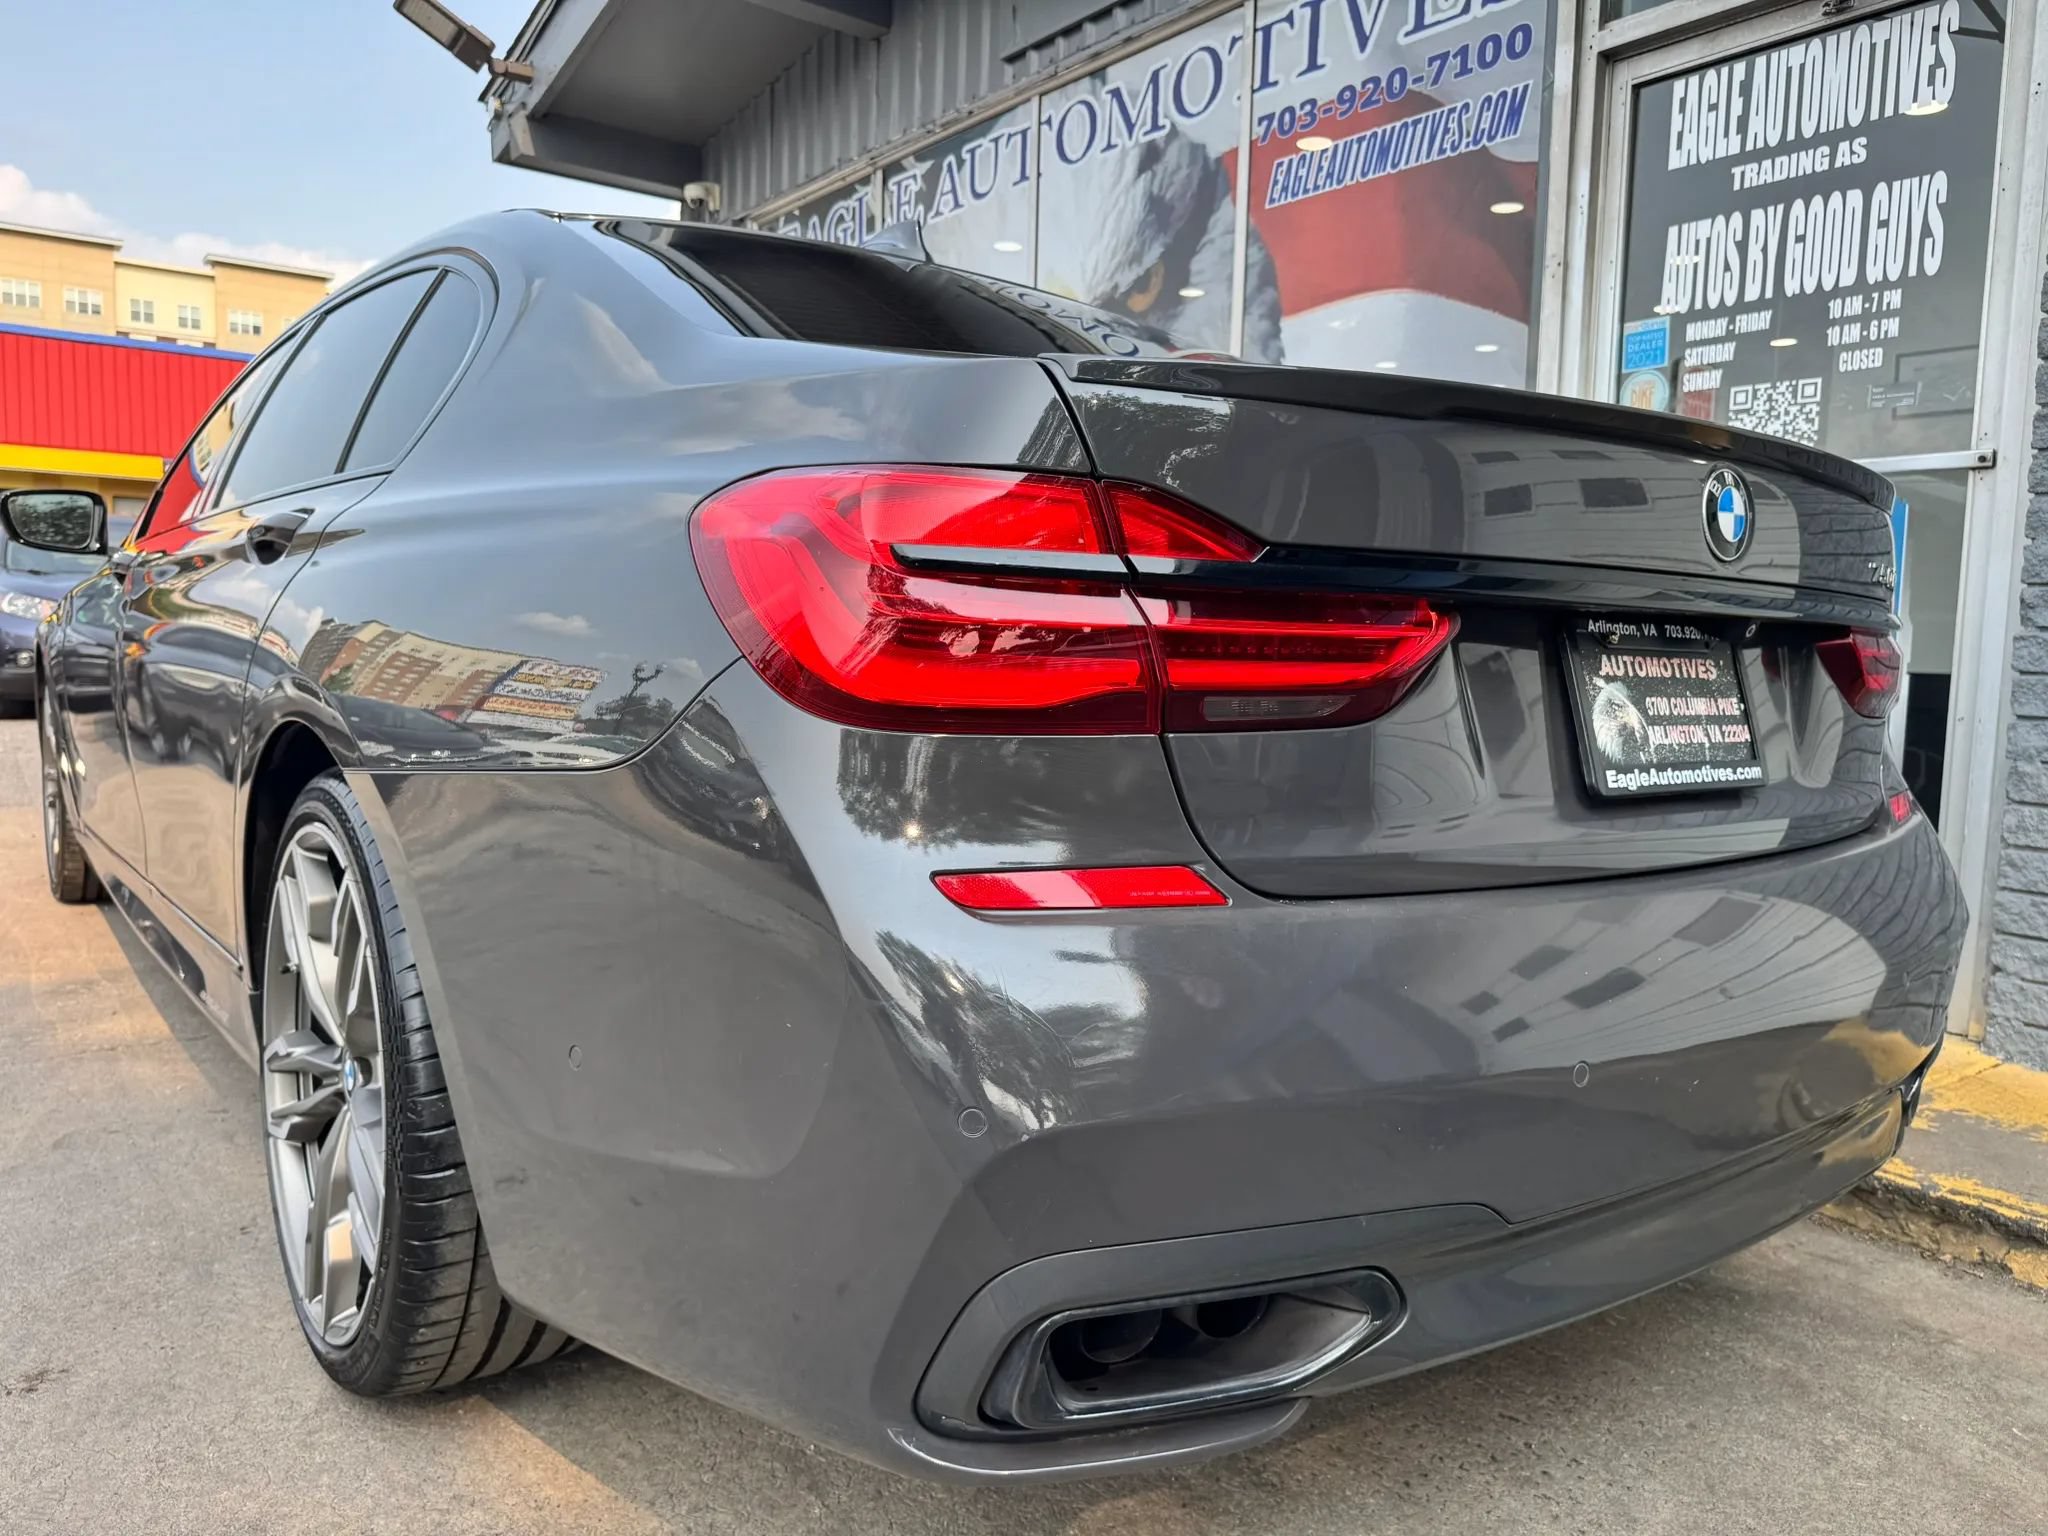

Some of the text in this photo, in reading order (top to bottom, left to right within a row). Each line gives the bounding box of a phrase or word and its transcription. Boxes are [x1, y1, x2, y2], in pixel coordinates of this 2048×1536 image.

[1257, 22, 1533, 146] 703-920-7100
[1667, 0, 1960, 171] EAGLE AUTOMOTIVES
[1266, 80, 1533, 208] EAGLEAUTOMOTIVES.COM
[1731, 136, 1868, 191] TRADING AS
[1660, 171, 1949, 315] AUTOS BY GOOD GUYS
[1828, 299, 1842, 319] 10
[1843, 295, 1863, 317] AM
[1871, 292, 1879, 312] 7
[1882, 288, 1902, 311] PM
[1685, 317, 1728, 342] MONDAY
[1735, 310, 1772, 335] FRIDAY
[1826, 326, 1840, 347] 10
[1841, 322, 1861, 345] AM
[1869, 319, 1878, 341] 6
[1879, 316, 1900, 339] PM
[1628, 339, 1663, 353] DEALER
[1628, 350, 1661, 368] 2021
[1683, 342, 1736, 368] SATURDAY
[1838, 347, 1884, 372] CLOSED
[1682, 368, 1723, 393] SUNDAY
[1588, 619, 1640, 638] Arlington,
[1642, 623, 1658, 637] VA
[1599, 654, 1717, 680] AUTOMOTIVES
[1670, 697, 1717, 716] COLUMBIA
[1717, 697, 1741, 716] PIKE
[1708, 724, 1723, 743] VA
[1722, 724, 1752, 743] 22204
[1605, 765, 1762, 790] EagleAutomotives.com
